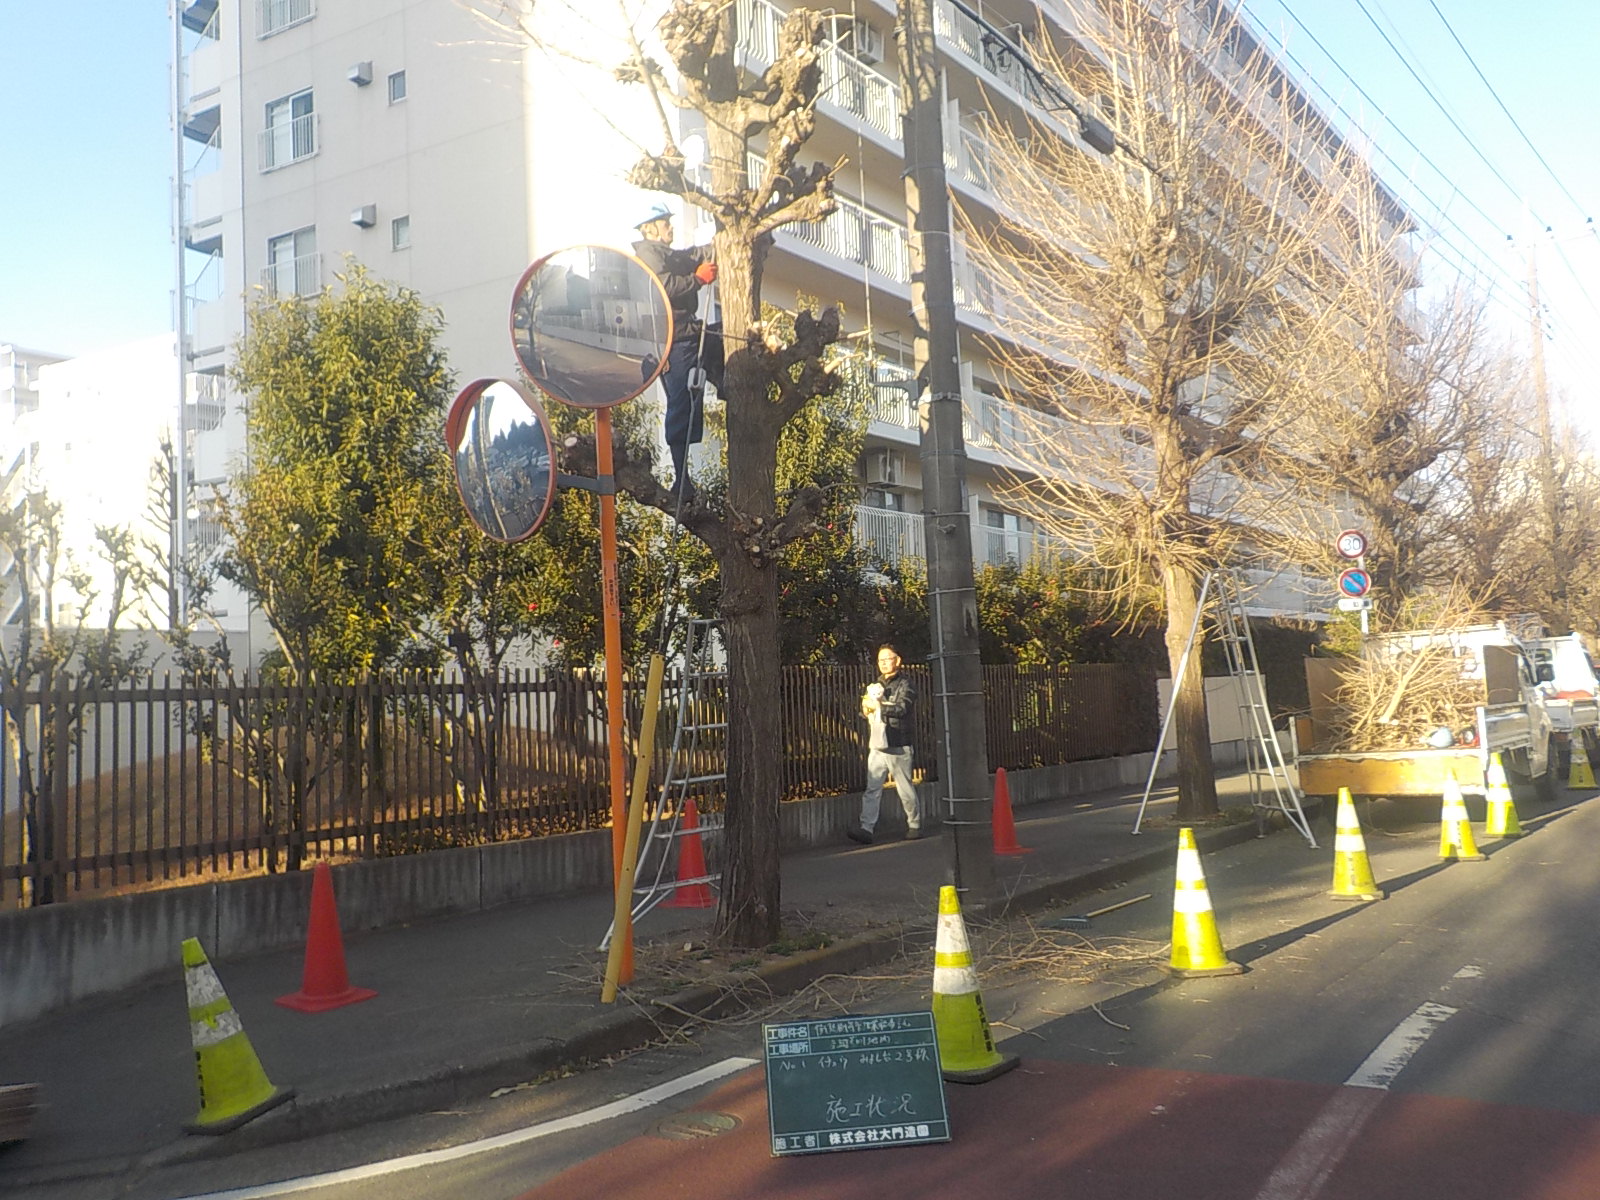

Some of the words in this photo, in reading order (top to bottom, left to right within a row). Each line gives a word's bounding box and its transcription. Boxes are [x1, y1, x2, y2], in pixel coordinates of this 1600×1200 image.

[1344, 538, 1361, 551] 30
[768, 1026, 808, 1040] 工事件名
[769, 1042, 809, 1056] 工事場所
[826, 1093, 916, 1124] 施工状況
[829, 1125, 930, 1145] 株式会社大門造園
[775, 1135, 816, 1150] 施工者
